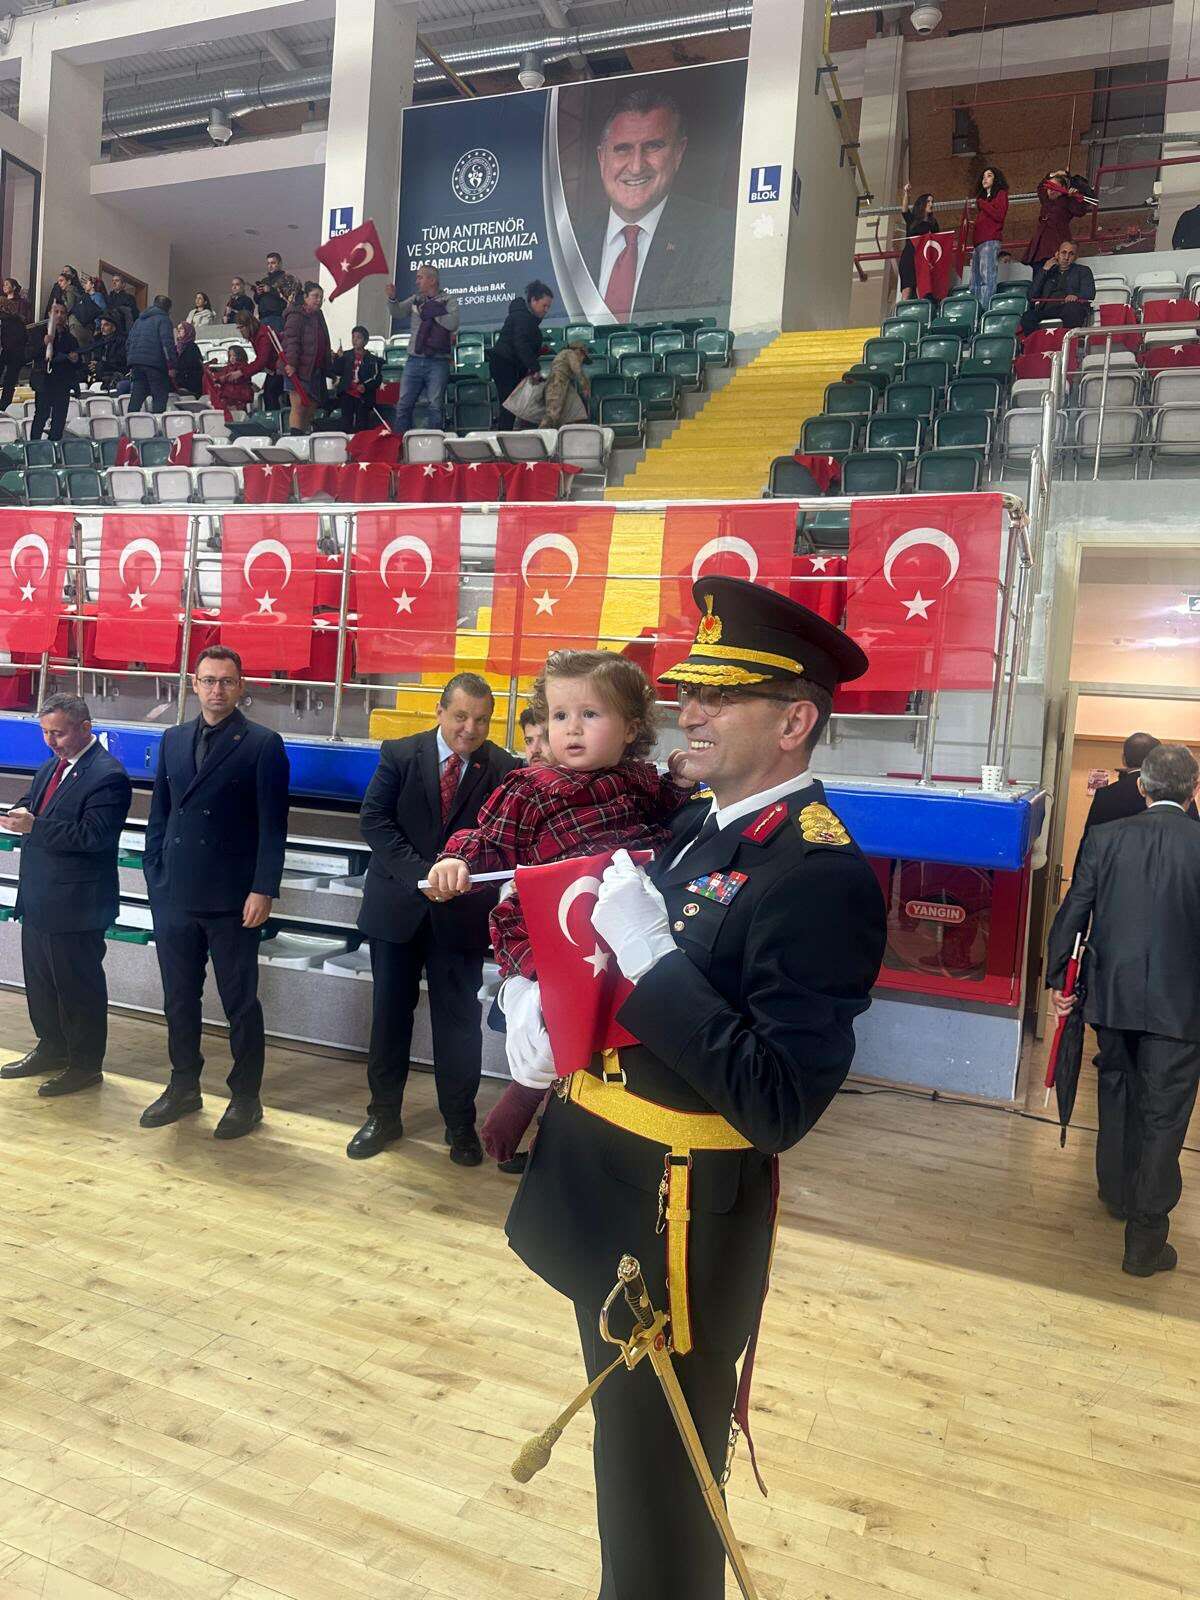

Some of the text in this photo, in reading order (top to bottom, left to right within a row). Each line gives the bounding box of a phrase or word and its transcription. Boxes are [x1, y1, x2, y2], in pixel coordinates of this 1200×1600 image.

[757, 168, 773, 191] L
[751, 190, 777, 200] BLOK
[335, 209, 347, 229] L
[422, 218, 525, 241] TÜM ANTRENÖR
[407, 233, 538, 257] VE SPORCULARIMIZA
[471, 250, 533, 266] DİLİYORUM
[469, 284, 489, 294] Aşkın
[490, 282, 506, 292] BAK
[464, 294, 486, 305] SPOR
[486, 292, 516, 303] BAKANI
[913, 904, 960, 919] YANGIN
